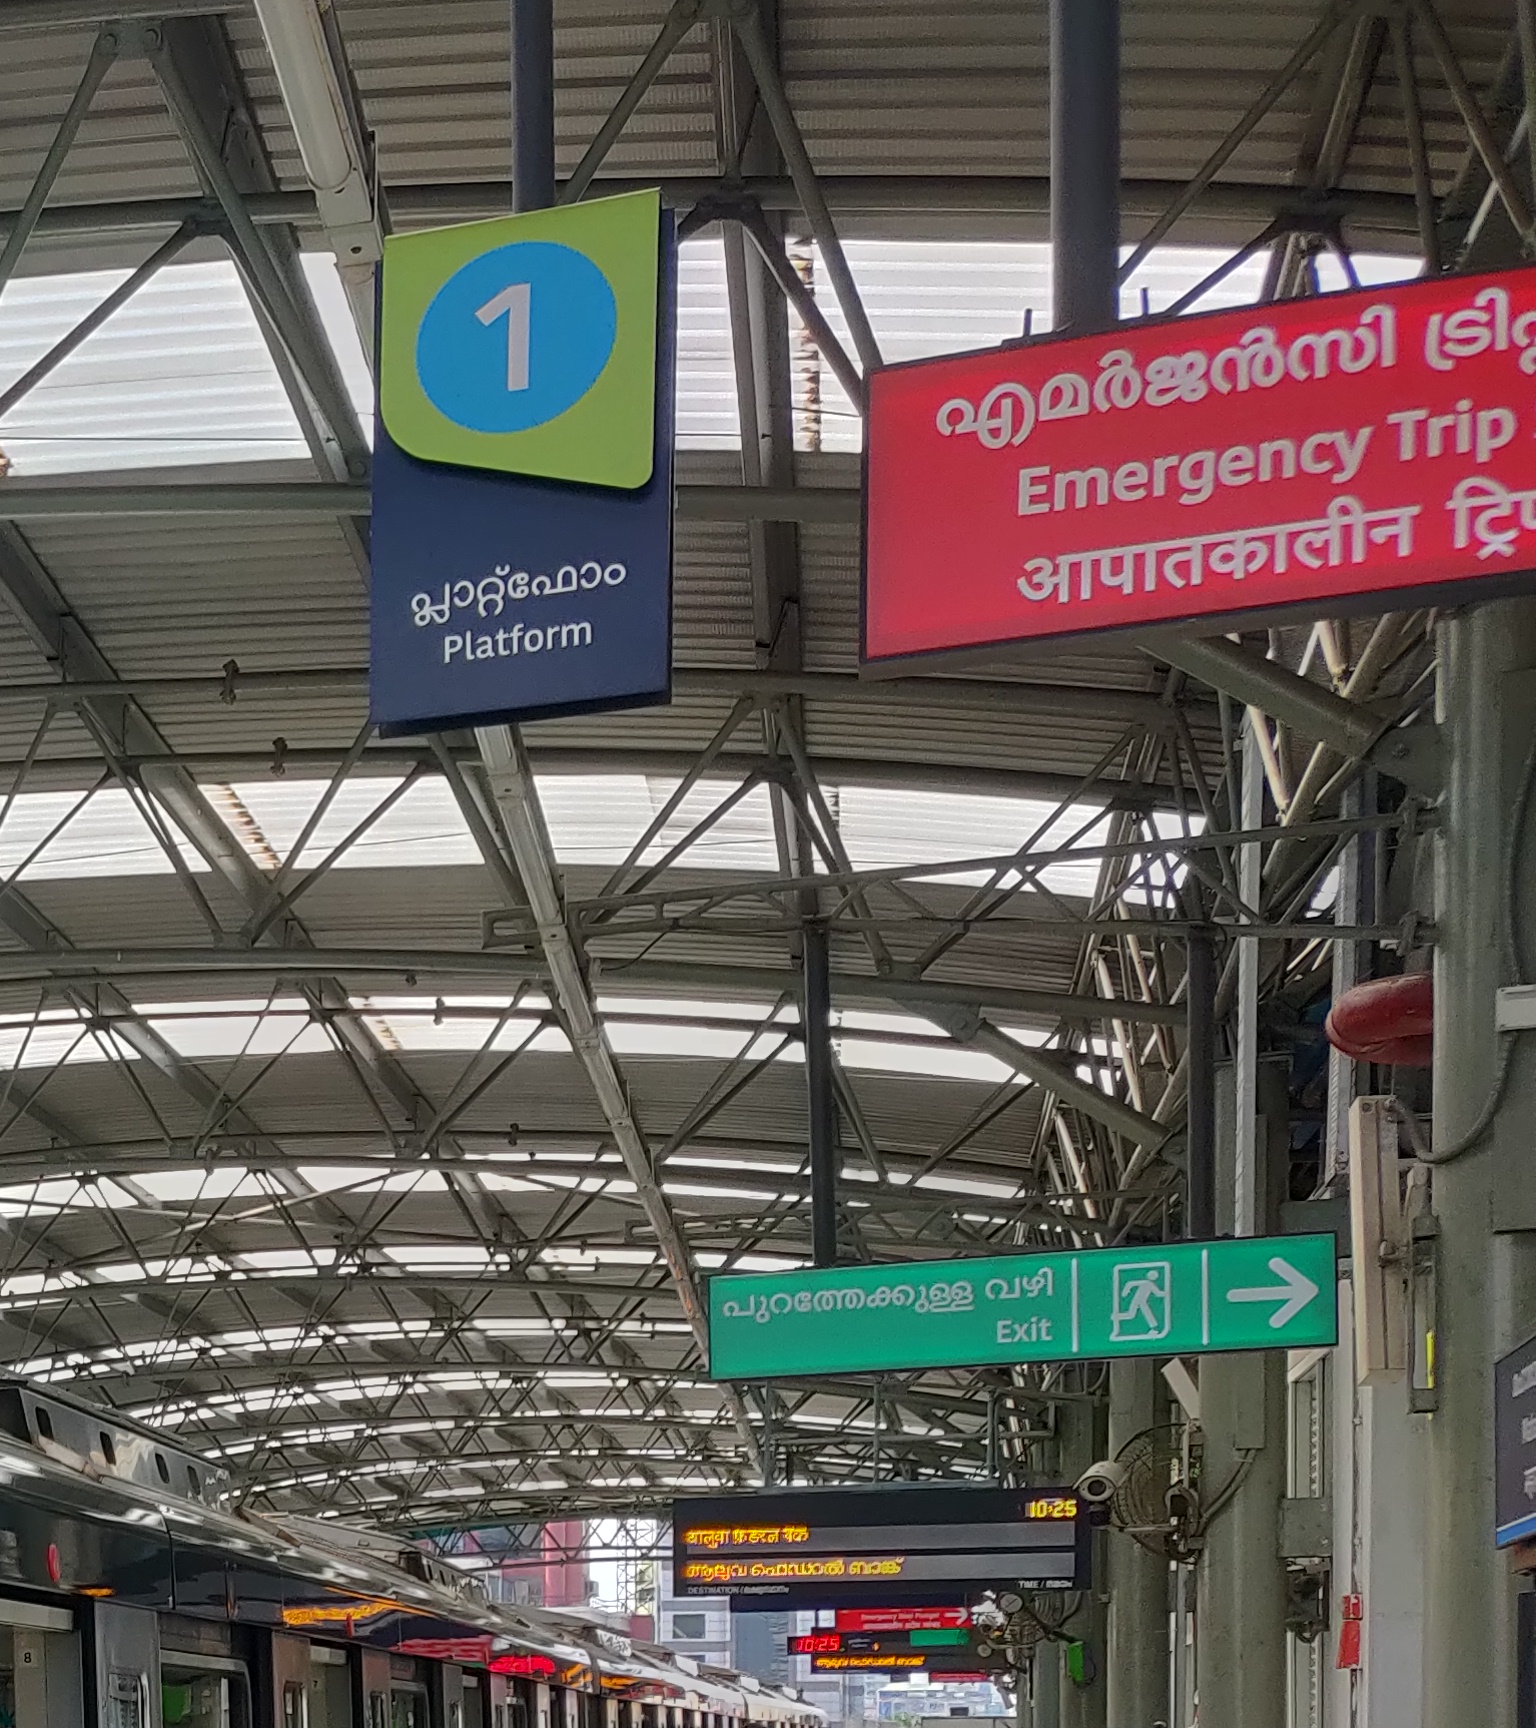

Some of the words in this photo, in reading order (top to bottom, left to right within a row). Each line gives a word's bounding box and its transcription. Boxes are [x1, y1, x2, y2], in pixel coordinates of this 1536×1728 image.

[474, 282, 532, 392] 1
[935, 302, 1397, 449] എമർജൻസി
[1017, 425, 1376, 516] Emergency
[1385, 397, 1518, 464] Trip
[1016, 495, 1423, 604] आपातकालीन
[443, 620, 593, 664] Platform
[721, 1280, 976, 1324] പുറത്തേക്കുള്ള
[984, 1266, 1054, 1300] വഴി
[996, 1315, 1054, 1344] Exit
[1028, 1499, 1077, 1519] 10:25
